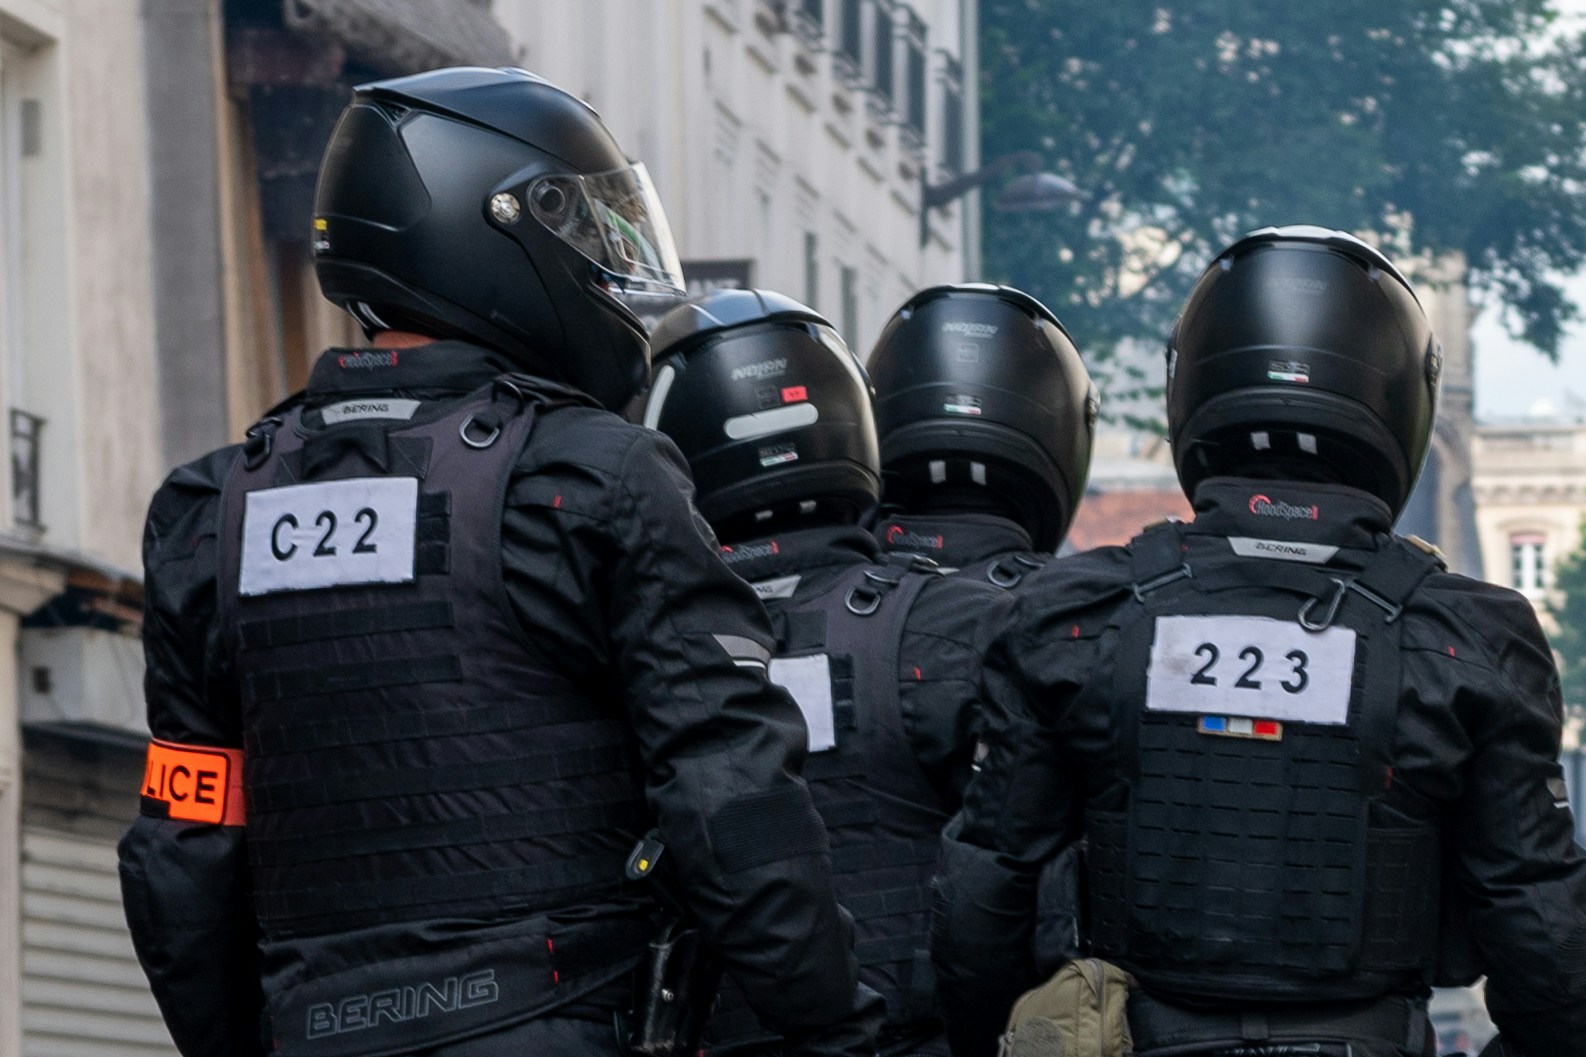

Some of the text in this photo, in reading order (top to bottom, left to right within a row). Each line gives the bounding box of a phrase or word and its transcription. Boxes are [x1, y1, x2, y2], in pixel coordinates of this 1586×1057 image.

[343, 404, 390, 415] BERING
[271, 506, 379, 562] C22
[1255, 541, 1308, 556] BERING
[1190, 642, 1310, 694] 223
[146, 761, 218, 804] LICE
[306, 968, 499, 1040] BERING
